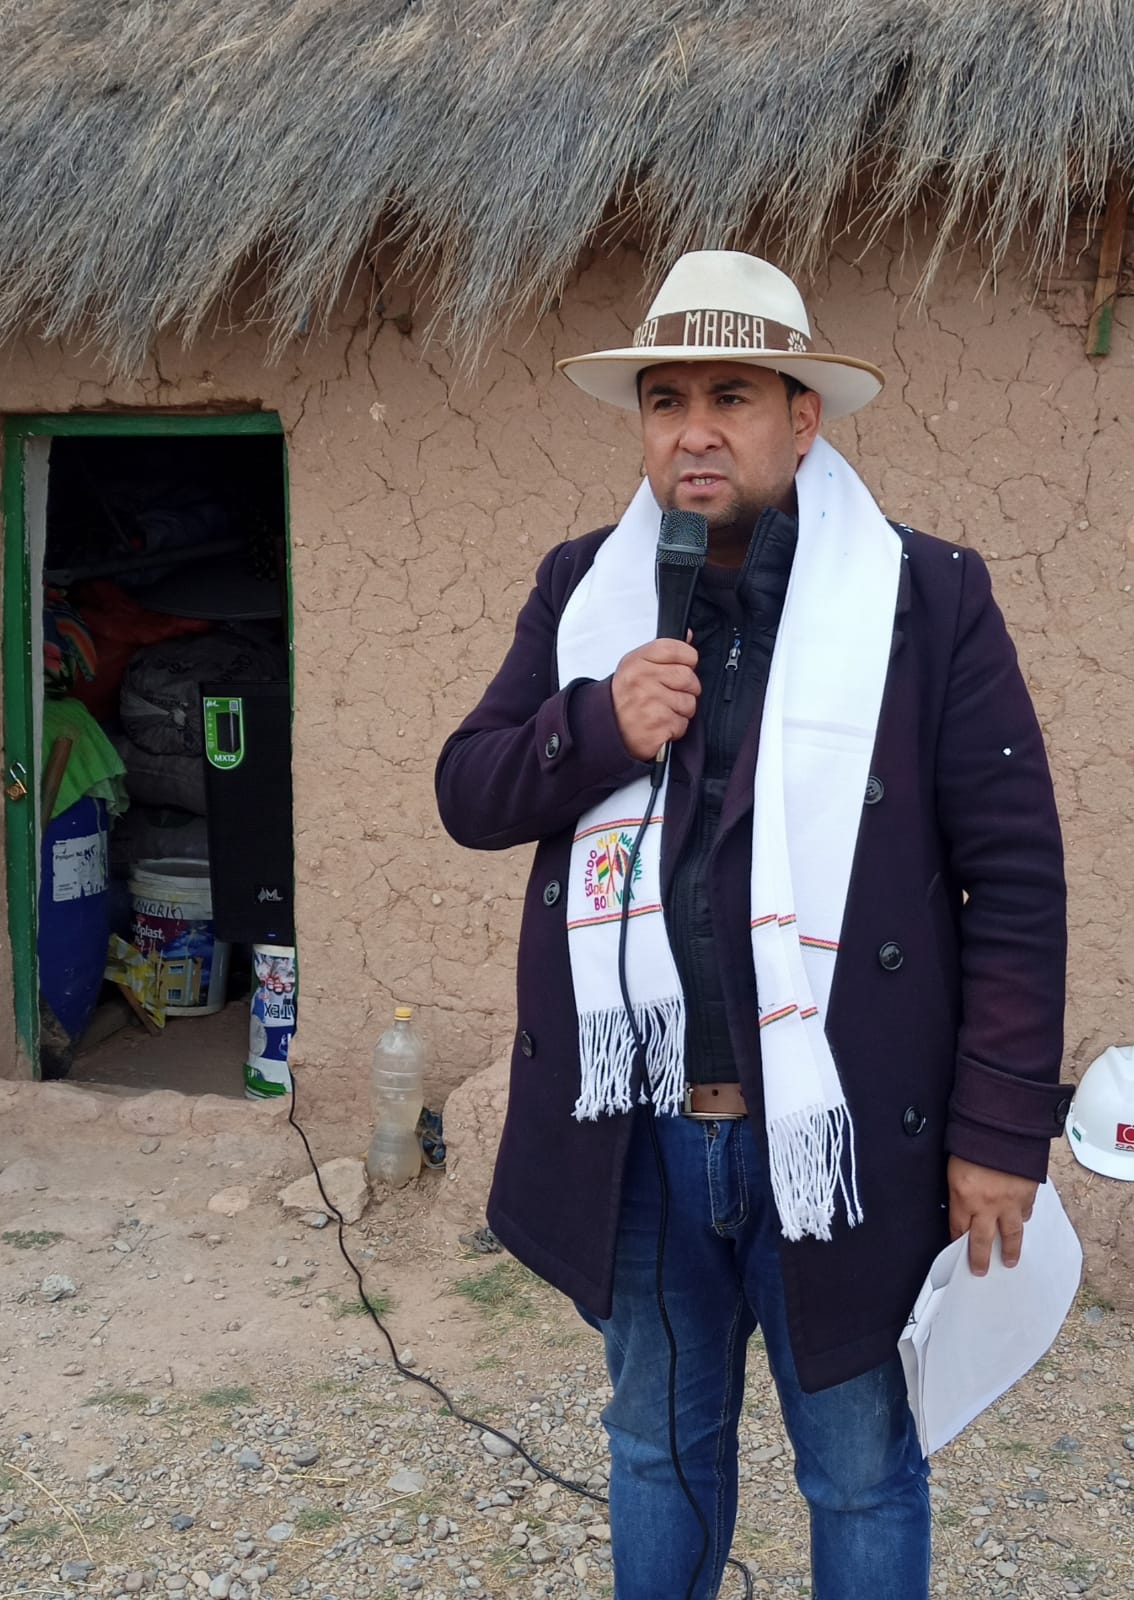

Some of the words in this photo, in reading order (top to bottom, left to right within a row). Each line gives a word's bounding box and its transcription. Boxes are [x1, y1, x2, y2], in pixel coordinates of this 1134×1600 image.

[683, 310, 765, 349] MARKA
[214, 754, 236, 762] MX12
[585, 850, 598, 898] ESTADO
[593, 883, 605, 896] DE
